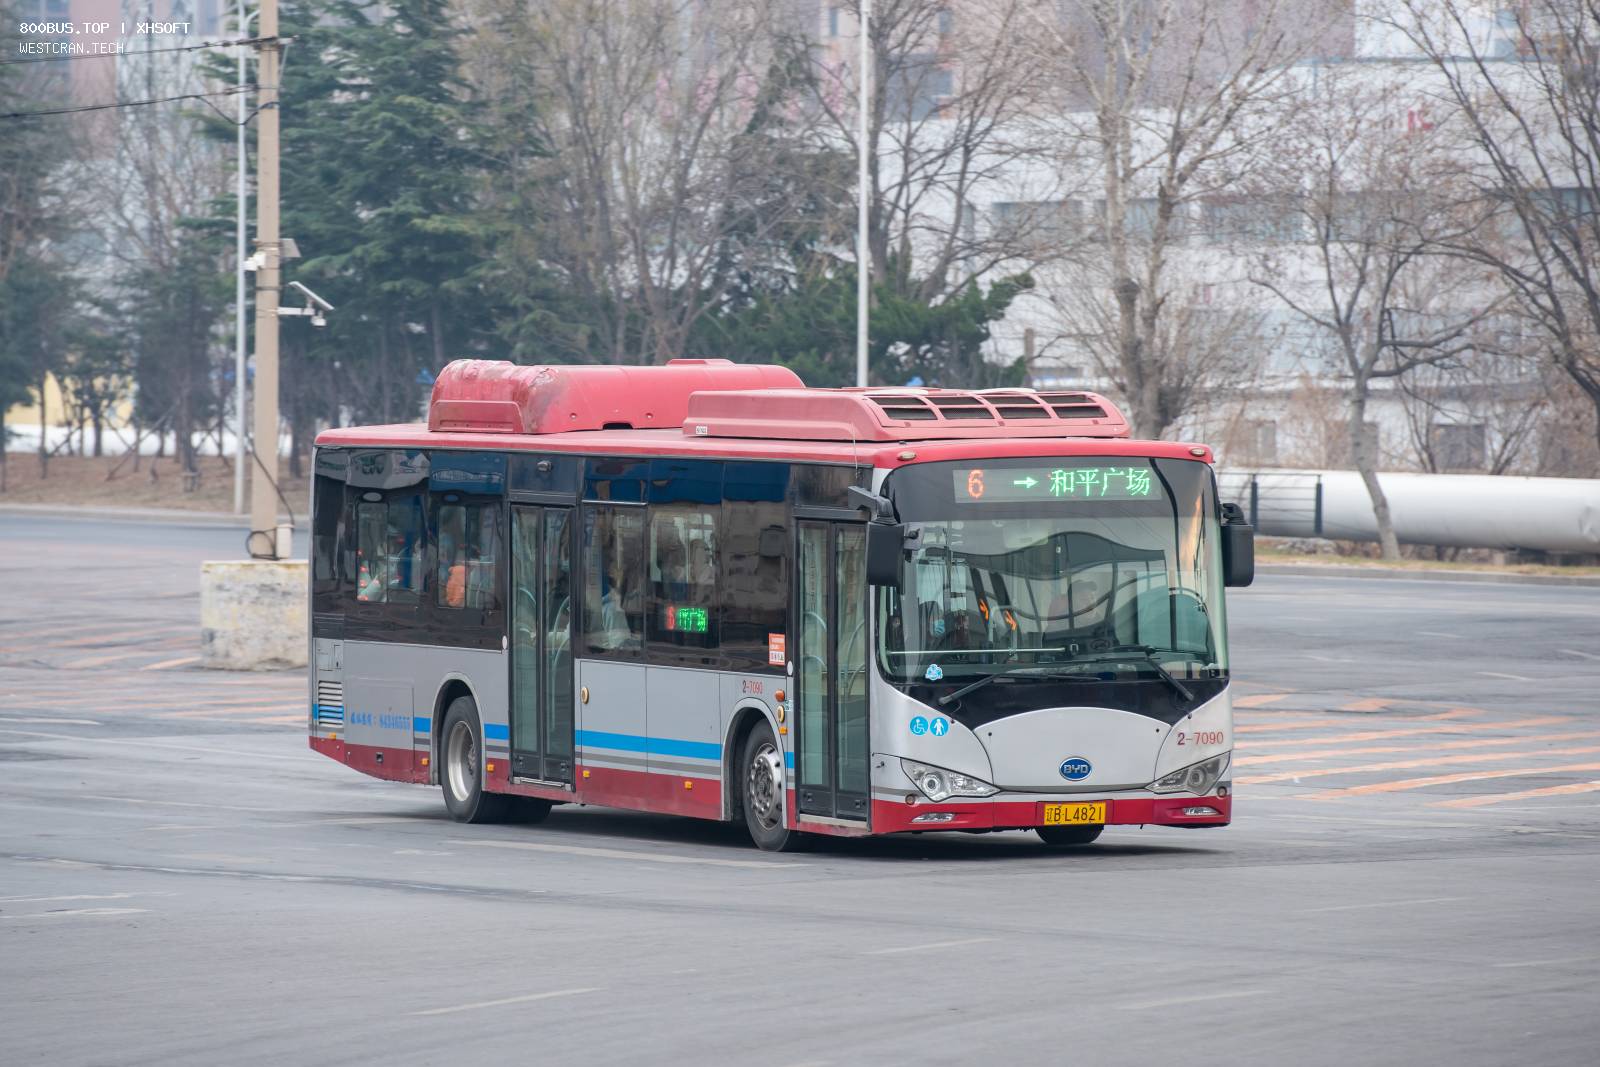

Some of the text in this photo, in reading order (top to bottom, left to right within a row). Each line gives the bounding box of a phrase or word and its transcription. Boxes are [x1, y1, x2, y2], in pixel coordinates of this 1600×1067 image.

[968, 467, 1150, 498] 6 和平广场
[742, 680, 763, 694] 2-7090
[1177, 732, 1224, 746] 2-7090
[1063, 764, 1089, 774] BYD
